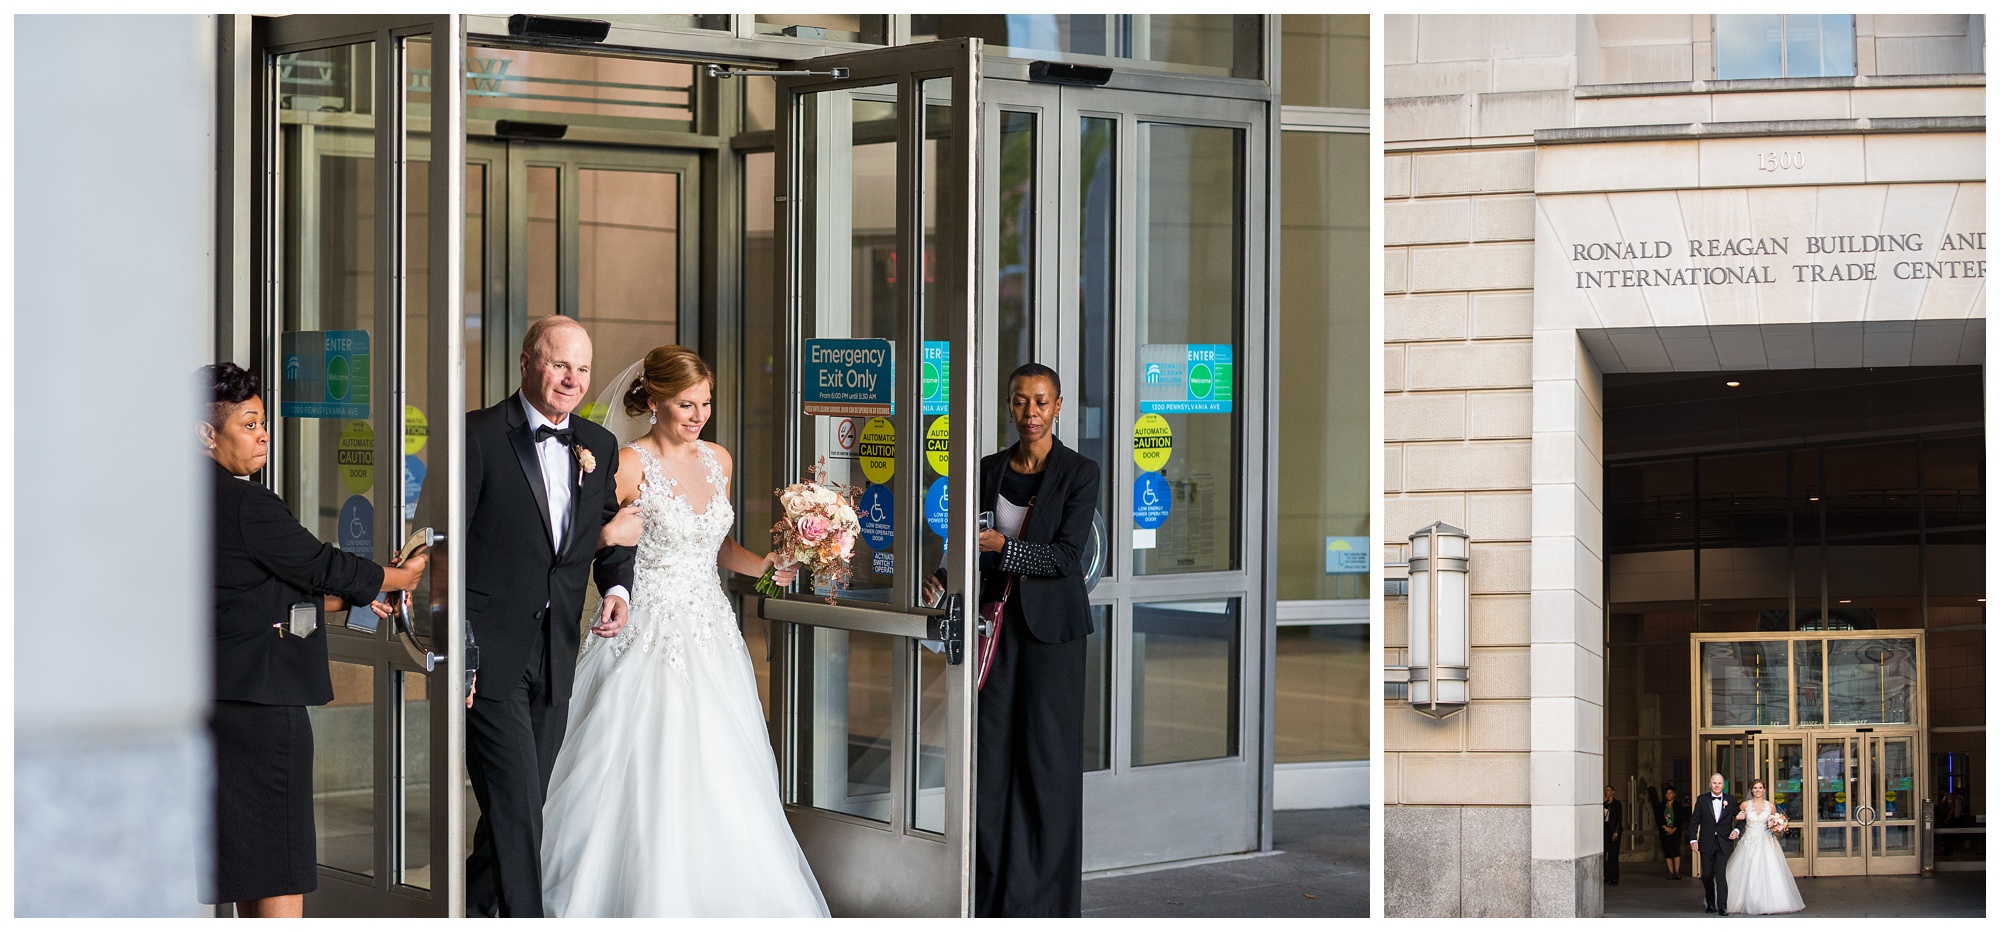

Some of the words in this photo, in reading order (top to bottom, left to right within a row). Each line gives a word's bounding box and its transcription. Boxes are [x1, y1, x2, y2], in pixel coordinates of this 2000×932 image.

[1758, 151, 1805, 172] 1300
[1573, 241, 1672, 261] RONALD
[1689, 237, 1789, 257] REAGAN
[1806, 233, 1923, 254] BUILDING
[1576, 266, 1776, 289] INTERNATIONAL
[1792, 262, 1877, 283] TRADE
[325, 338, 352, 351] ENTER
[812, 345, 885, 368] Emergency
[924, 348, 942, 359] TER
[1188, 350, 1215, 362] ENTER
[819, 369, 843, 388] Exit
[846, 369, 877, 392] Only
[819, 392, 831, 400] From
[849, 392, 859, 400] until
[304, 406, 346, 415] PENNSYLVANIA
[348, 408, 358, 416] AVE
[863, 433, 895, 442] AUTOMATIC
[1133, 437, 1171, 448] CAUTION
[927, 440, 948, 450] CAU
[1143, 451, 1160, 459] DOOR
[870, 460, 887, 469] DOOR
[350, 469, 367, 478] DOOR
